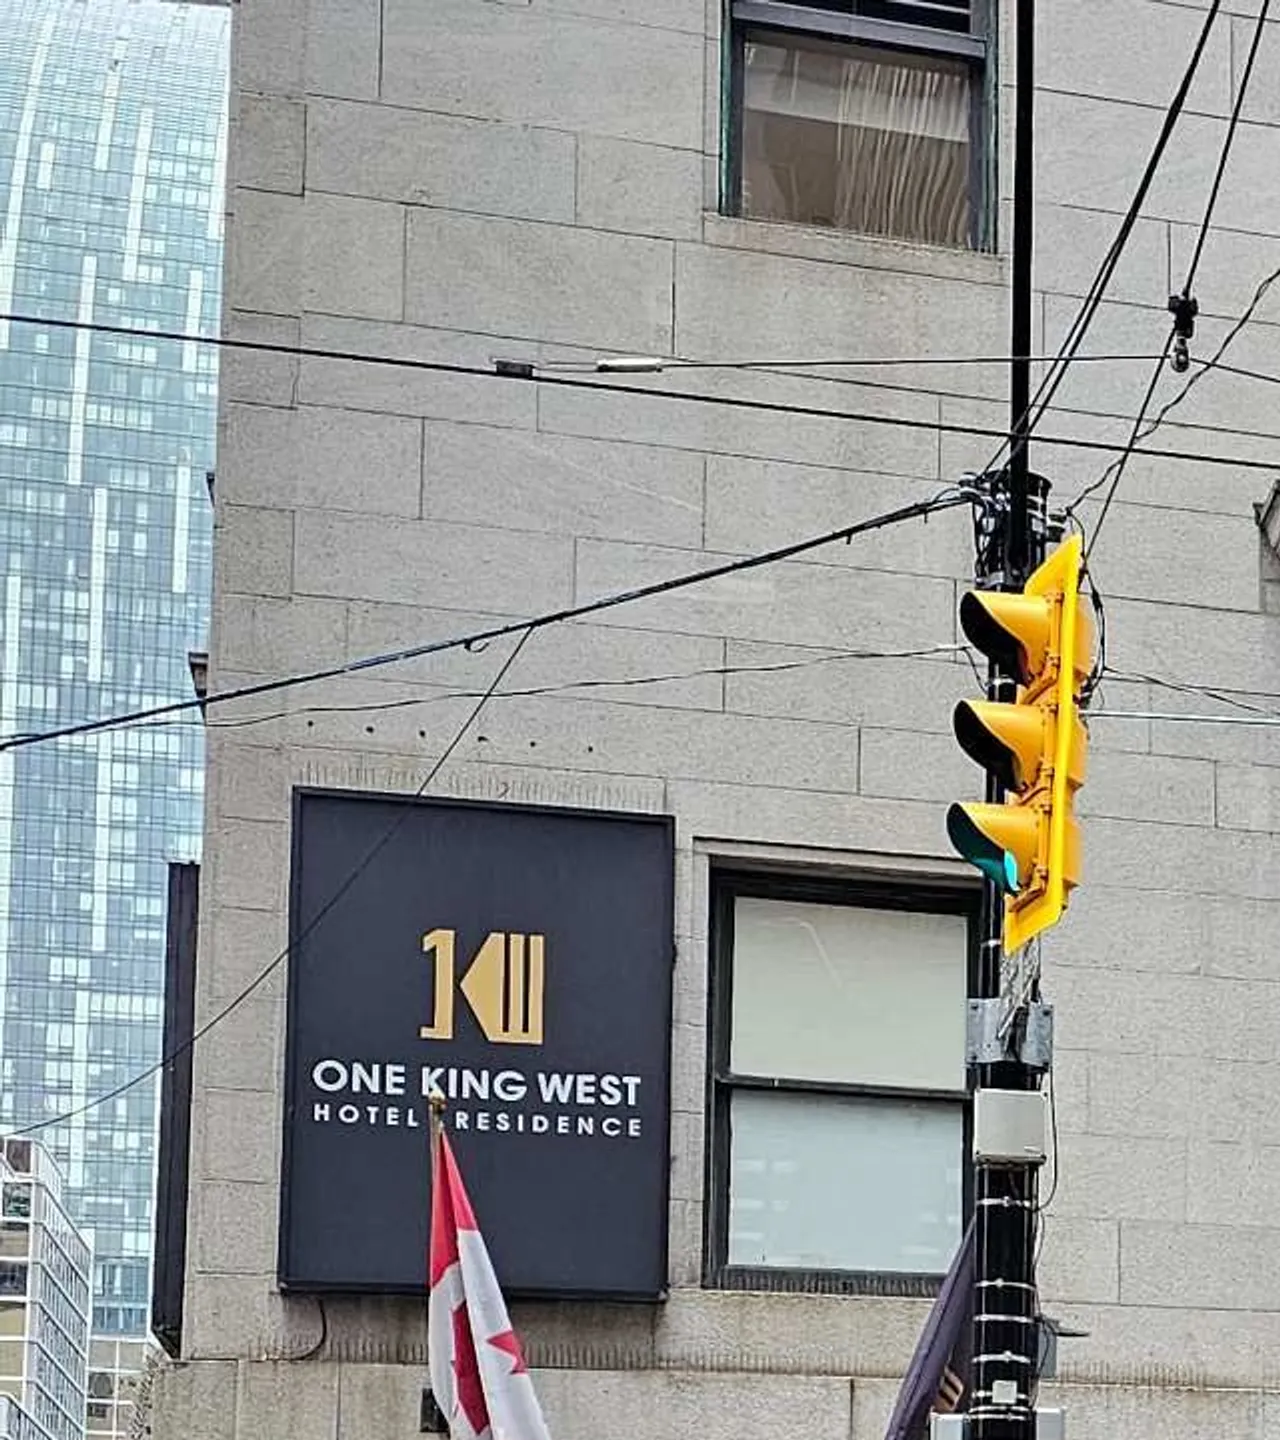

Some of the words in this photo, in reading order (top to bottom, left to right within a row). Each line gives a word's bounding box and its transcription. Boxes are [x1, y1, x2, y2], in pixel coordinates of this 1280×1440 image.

[312, 1059, 405, 1095] ONE
[421, 1066, 527, 1102] KING
[537, 1072, 642, 1106] WEST
[313, 1103, 418, 1128] HOTEL
[455, 1110, 642, 1137] RESIDENCE
